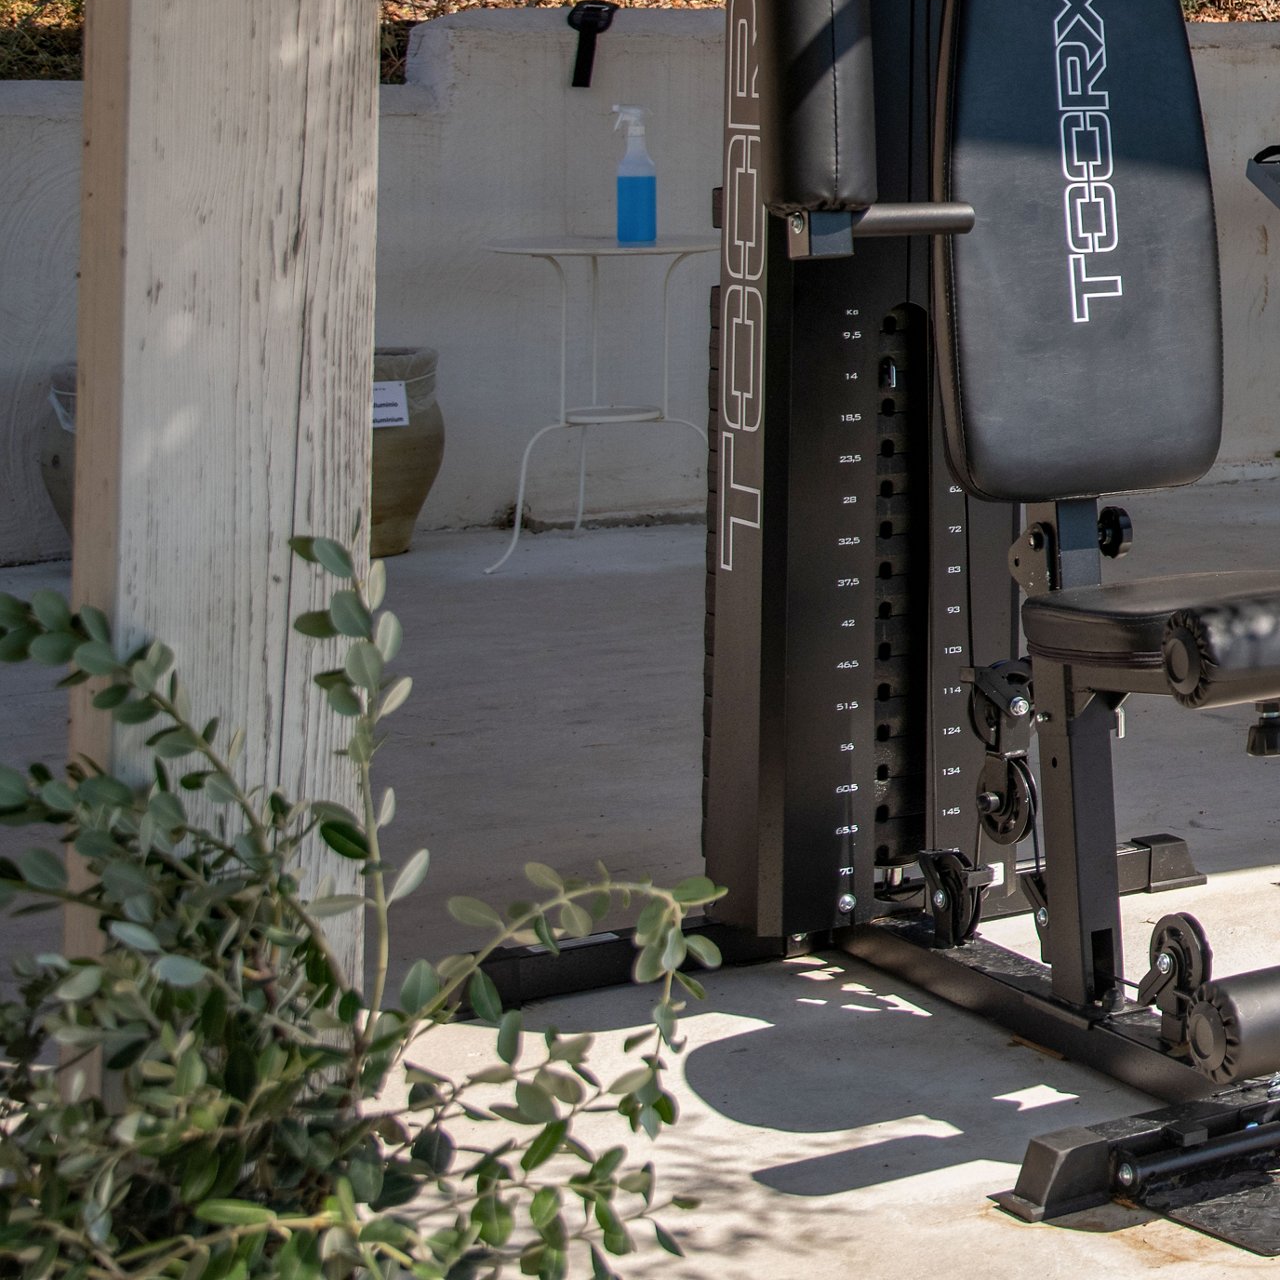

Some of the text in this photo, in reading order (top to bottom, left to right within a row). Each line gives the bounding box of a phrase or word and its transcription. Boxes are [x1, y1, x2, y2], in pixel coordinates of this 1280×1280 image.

[843, 331, 862, 340] 9,5
[845, 372, 858, 380] 14
[841, 413, 862, 422] 18,5
[839, 454, 862, 463] 23,5
[843, 495, 857, 504] 28
[948, 525, 962, 533] 72
[838, 536, 861, 546] 32,5
[947, 565, 961, 574] 83
[837, 577, 860, 587] 37,5
[947, 605, 961, 614] 93
[841, 619, 856, 627] 42
[944, 645, 963, 655] 103
[836, 660, 859, 669] 46,5
[943, 686, 962, 695] 114
[836, 701, 859, 711] 51,5
[943, 726, 962, 735] 124
[840, 742, 855, 752] 56
[942, 766, 961, 776] 134
[836, 783, 859, 794] 60,5
[942, 806, 961, 816] 145
[835, 824, 859, 835] 65,5
[839, 866, 854, 876] 70
